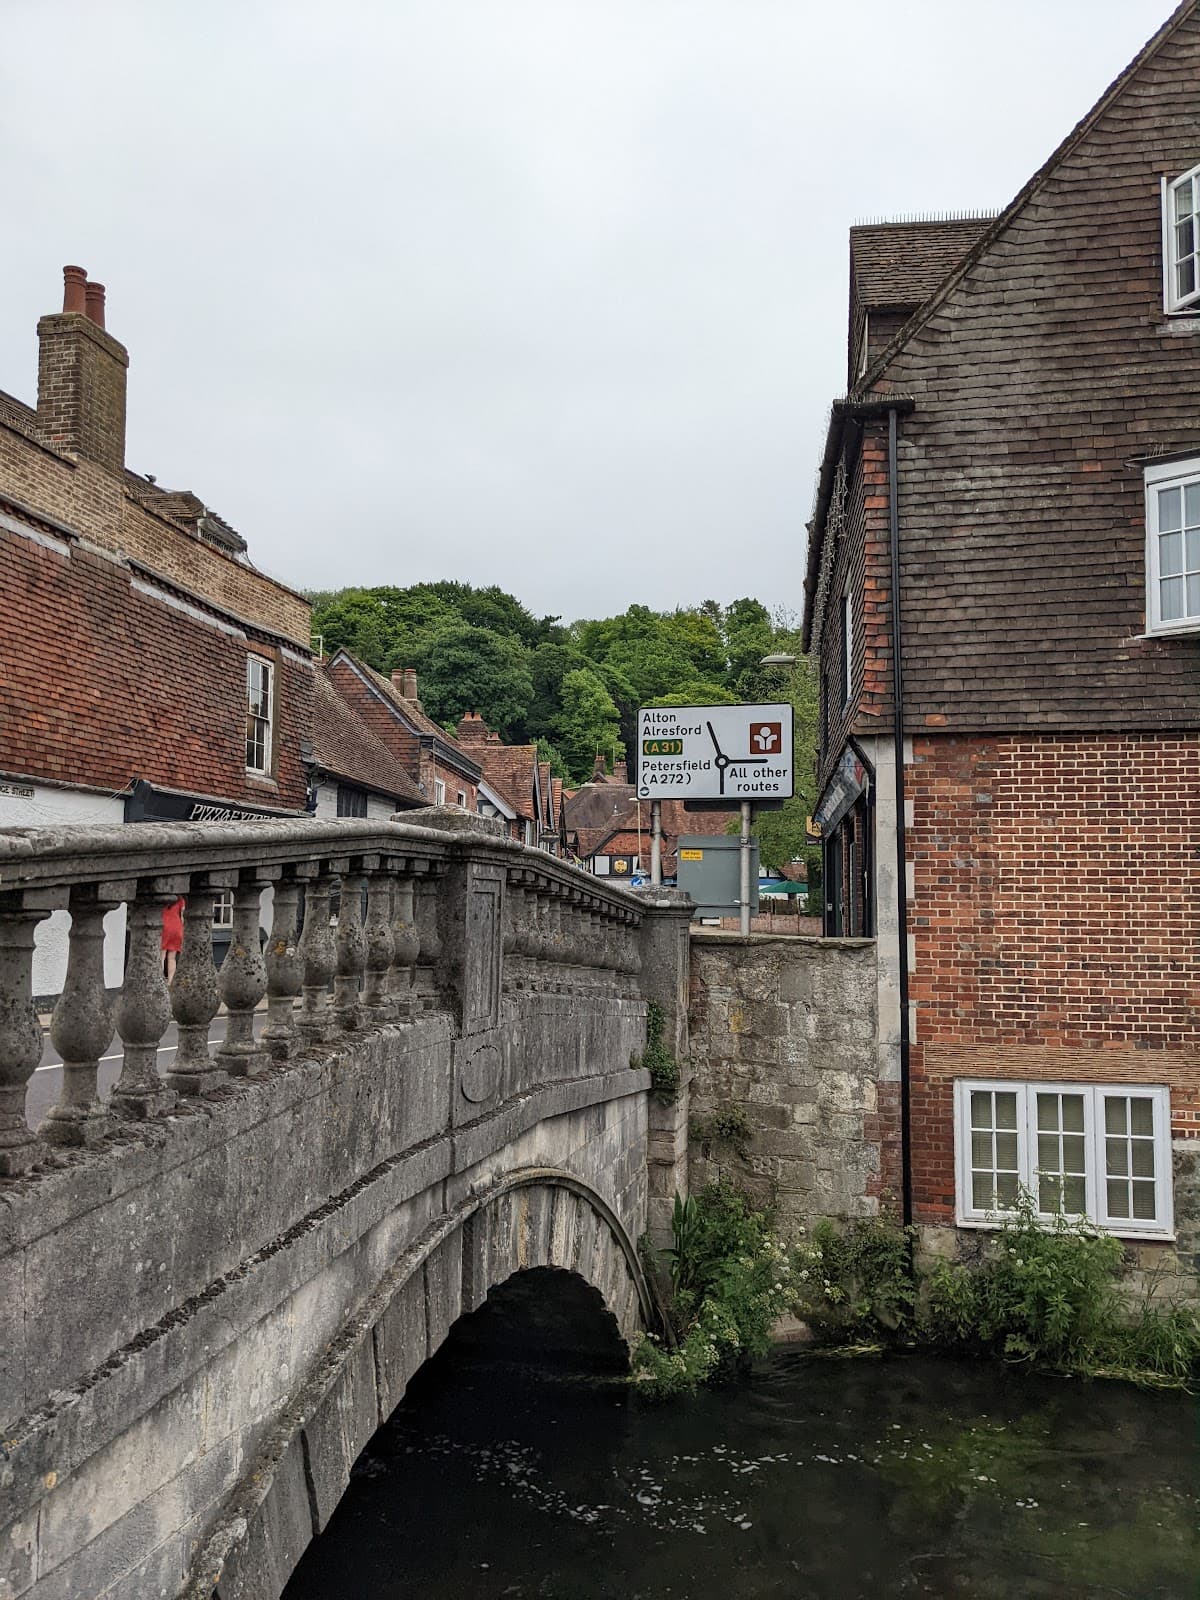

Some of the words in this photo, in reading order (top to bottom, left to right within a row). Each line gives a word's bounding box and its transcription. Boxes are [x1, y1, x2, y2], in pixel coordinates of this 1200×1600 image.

[643, 713, 676, 723] Alton
[643, 725, 702, 736] Alresford
[643, 742, 682, 753] (A31)
[642, 760, 711, 771] Petersfield
[729, 768, 747, 778] All
[753, 768, 788, 778] other
[642, 774, 691, 785] (A272)
[737, 782, 779, 792] routes
